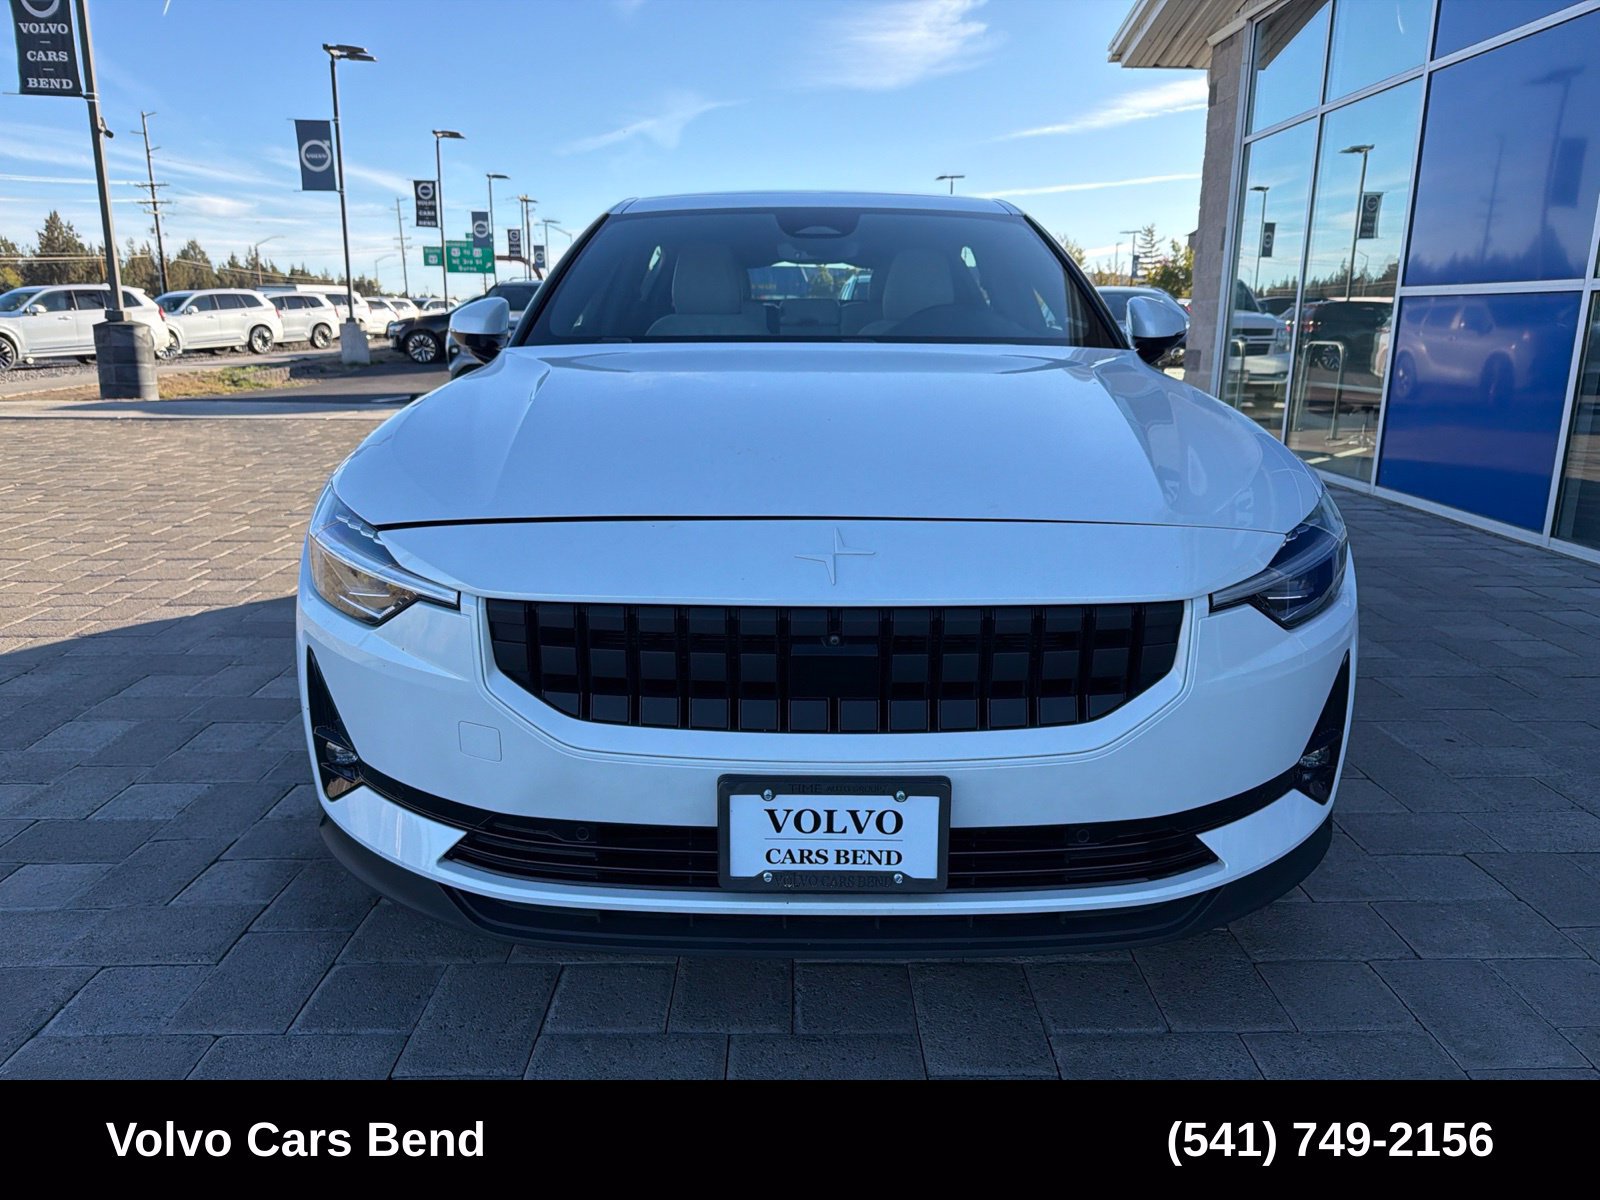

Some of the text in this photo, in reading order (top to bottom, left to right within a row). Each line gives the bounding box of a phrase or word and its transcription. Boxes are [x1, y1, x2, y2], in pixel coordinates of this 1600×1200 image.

[18, 22, 69, 34] VOLVO
[26, 50, 69, 62] CARS
[26, 77, 74, 90] BEND
[764, 808, 904, 835] VOLVO
[765, 848, 903, 866] CARS BEND
